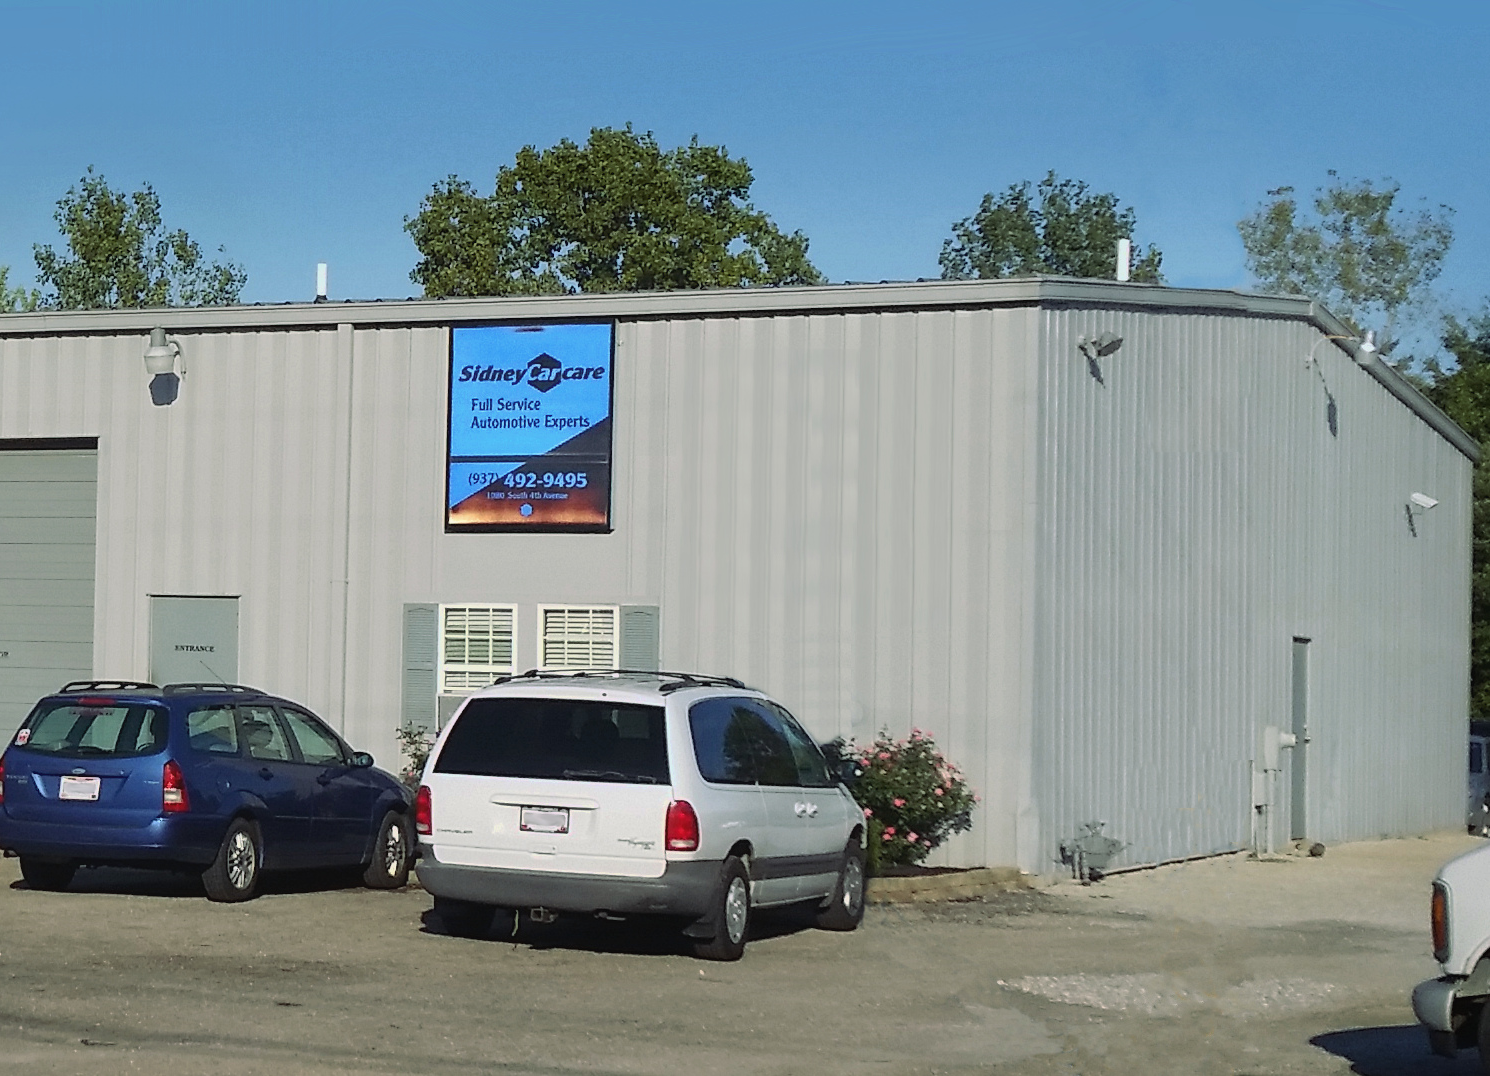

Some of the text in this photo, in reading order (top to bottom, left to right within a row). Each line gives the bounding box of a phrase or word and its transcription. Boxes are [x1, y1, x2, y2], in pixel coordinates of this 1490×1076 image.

[471, 397, 541, 411] Full Service
[470, 414, 590, 431] Automotive Experts
[468, 471, 588, 488] (937) 492-9495
